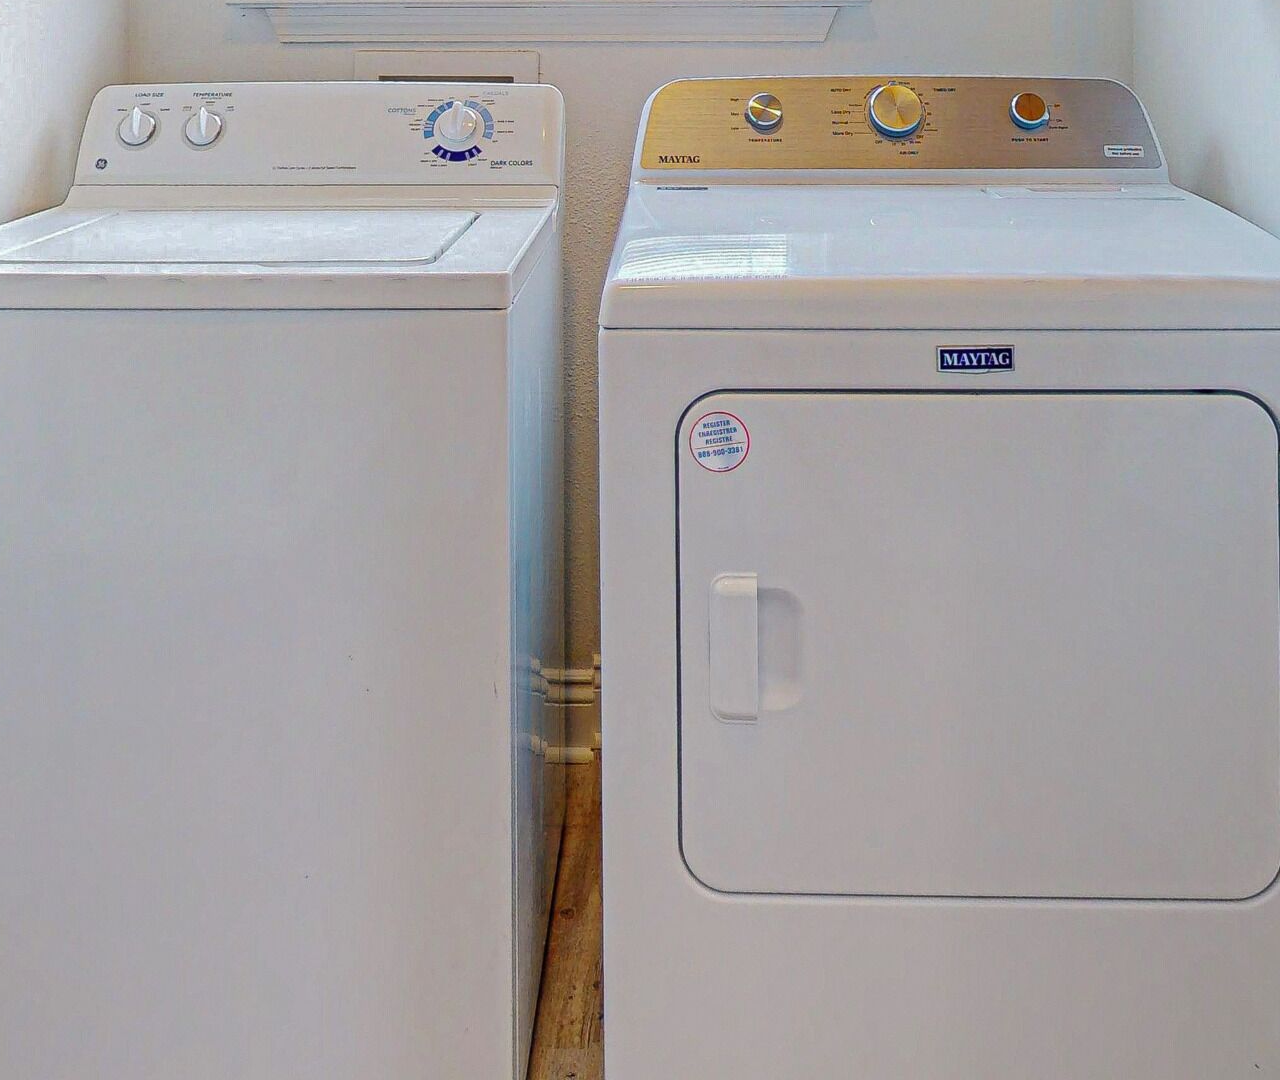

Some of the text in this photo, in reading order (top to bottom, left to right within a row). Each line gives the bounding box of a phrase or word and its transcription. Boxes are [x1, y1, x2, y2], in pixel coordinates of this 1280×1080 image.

[659, 155, 700, 163] MAYTAG
[943, 352, 1010, 366] MAYTAG
[703, 420, 730, 429] REGISTER
